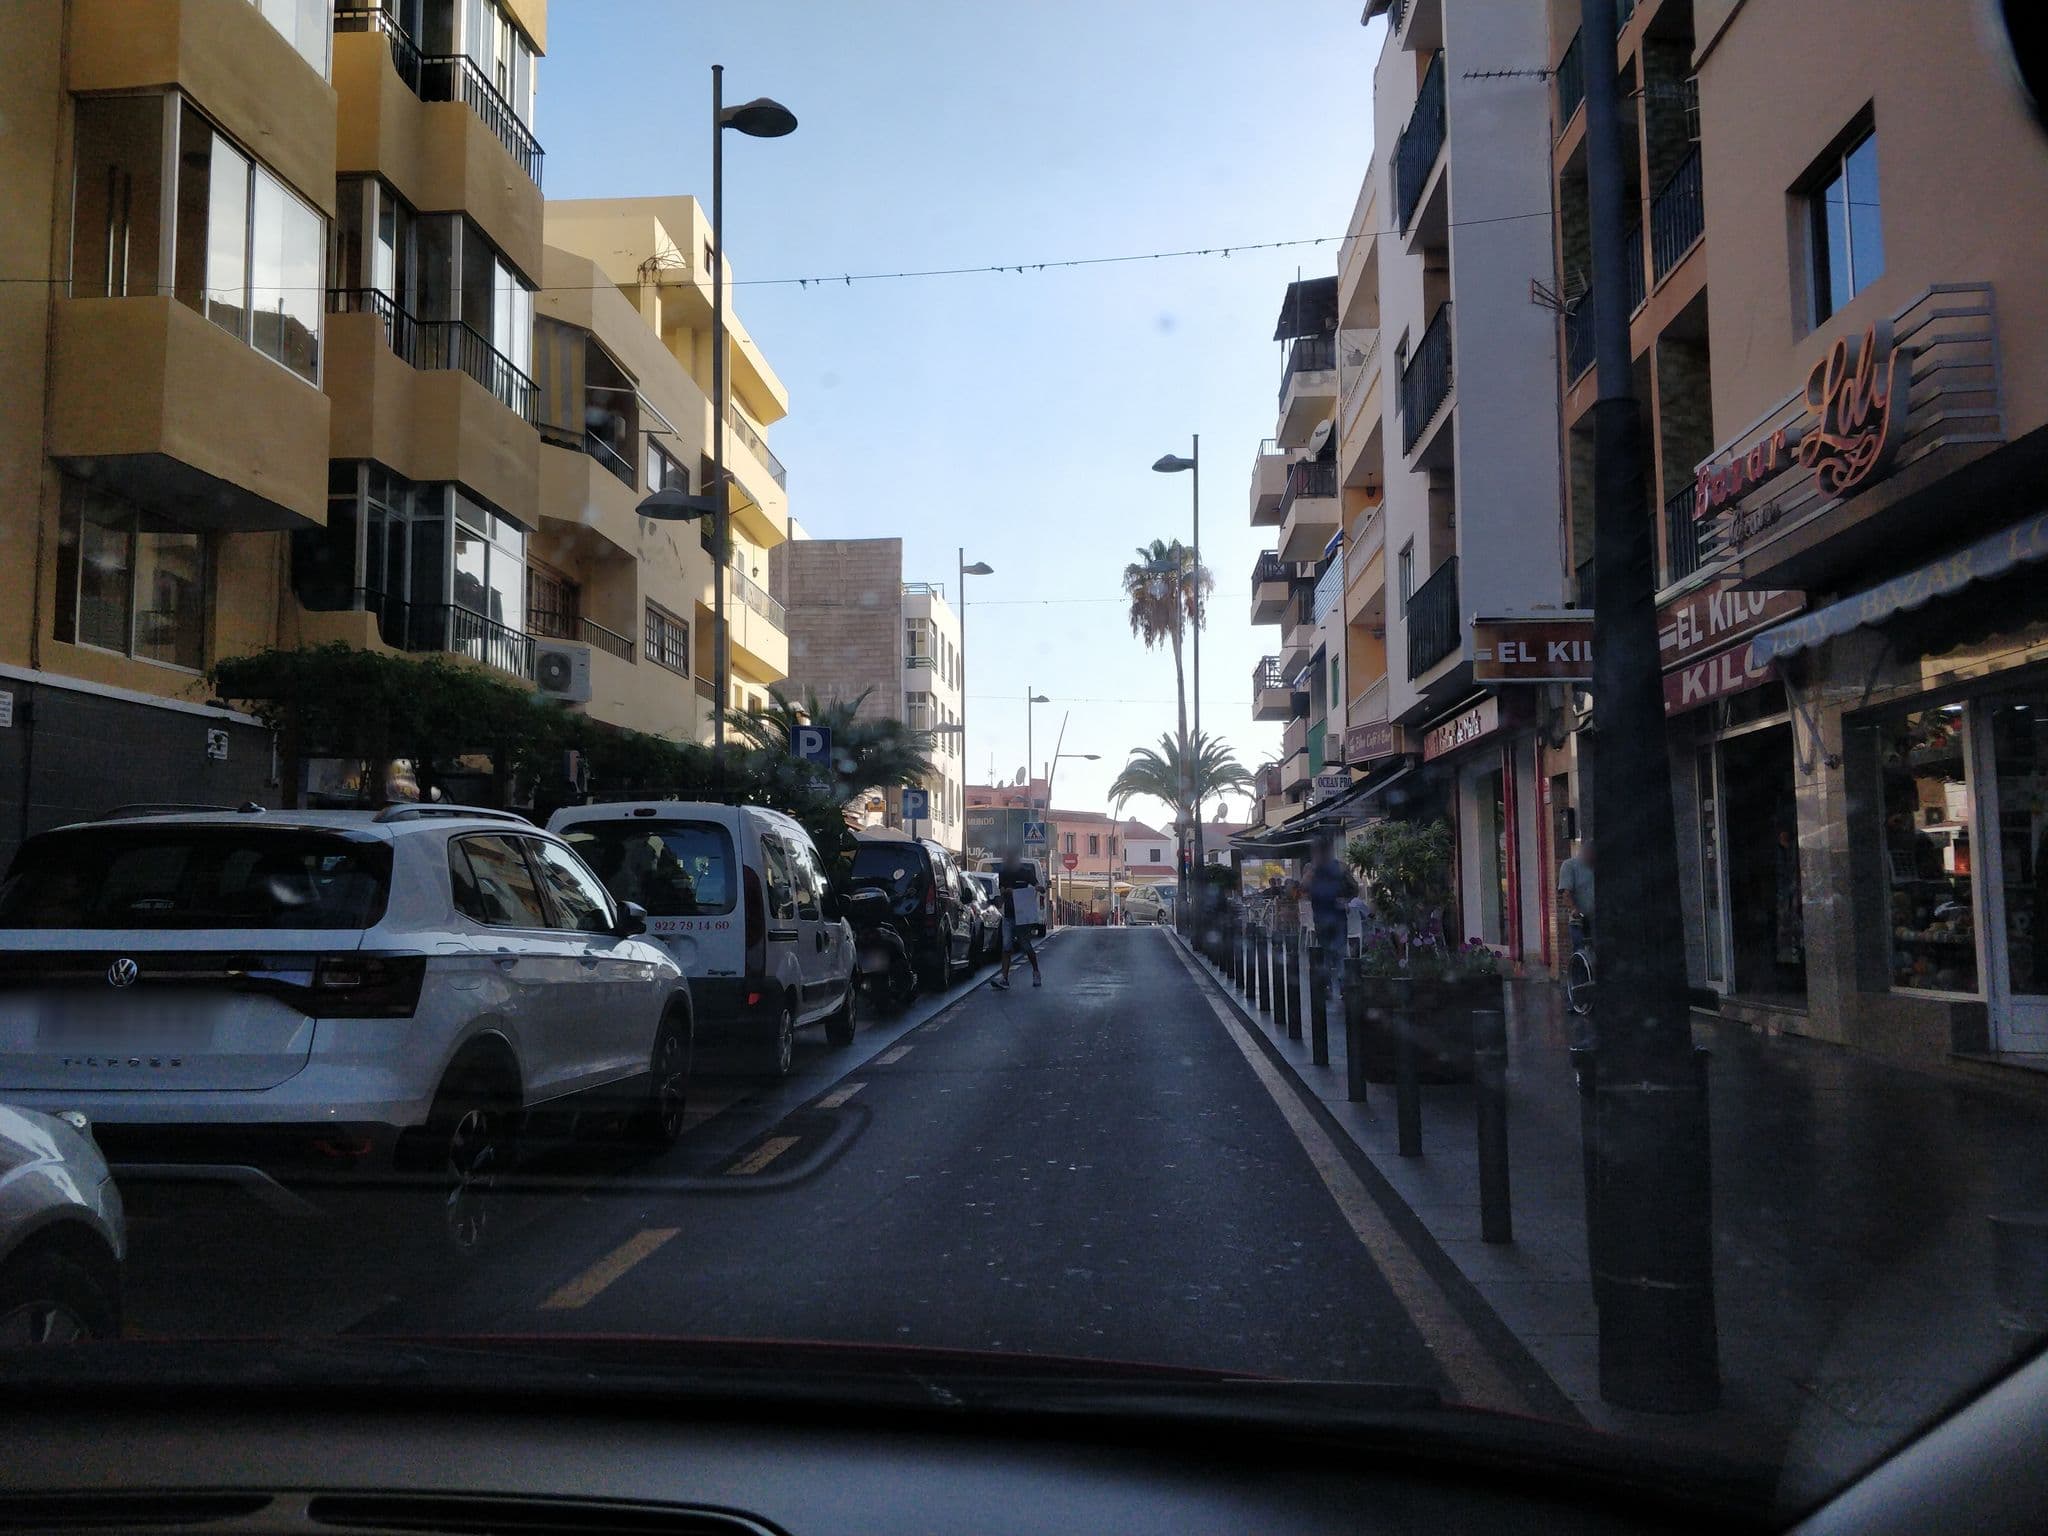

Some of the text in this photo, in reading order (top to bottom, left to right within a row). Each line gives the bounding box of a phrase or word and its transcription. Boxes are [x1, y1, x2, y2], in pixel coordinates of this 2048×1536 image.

[1677, 589, 1766, 650] EL KILO
[1498, 640, 1594, 663] EL KIL
[800, 729, 823, 759] P
[1318, 777, 1338, 787] OCEAN
[908, 793, 923, 816] P
[655, 921, 676, 931] 922
[680, 921, 693, 930] 79
[699, 920, 710, 930] 14
